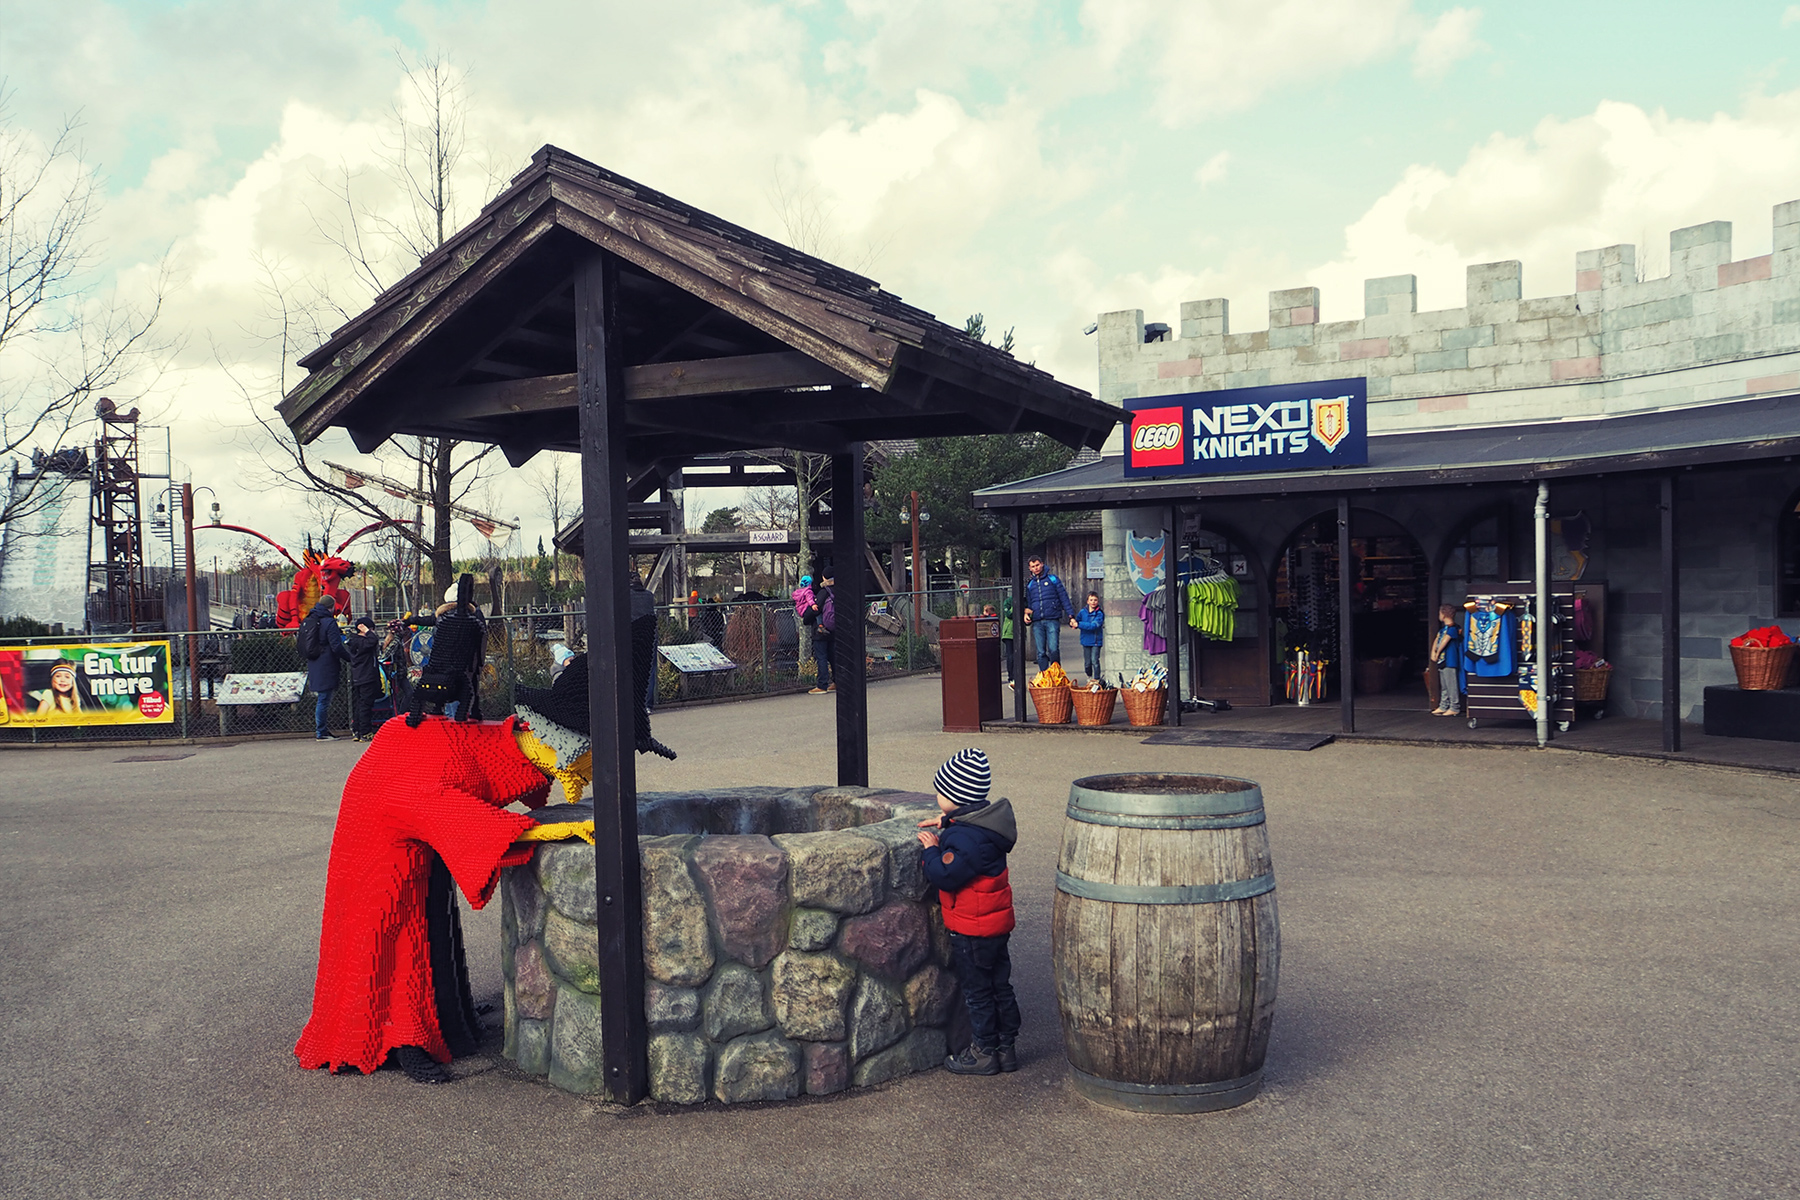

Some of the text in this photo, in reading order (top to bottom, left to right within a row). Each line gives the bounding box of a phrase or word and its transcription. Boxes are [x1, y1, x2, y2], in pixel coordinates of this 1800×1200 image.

[1193, 399, 1309, 436] NEXO
[1134, 424, 1180, 450] LEGO
[1193, 430, 1310, 460] KNIGHTS
[752, 532, 785, 542] ASGAARD
[84, 652, 157, 675] En tur
[90, 677, 154, 696] mere
